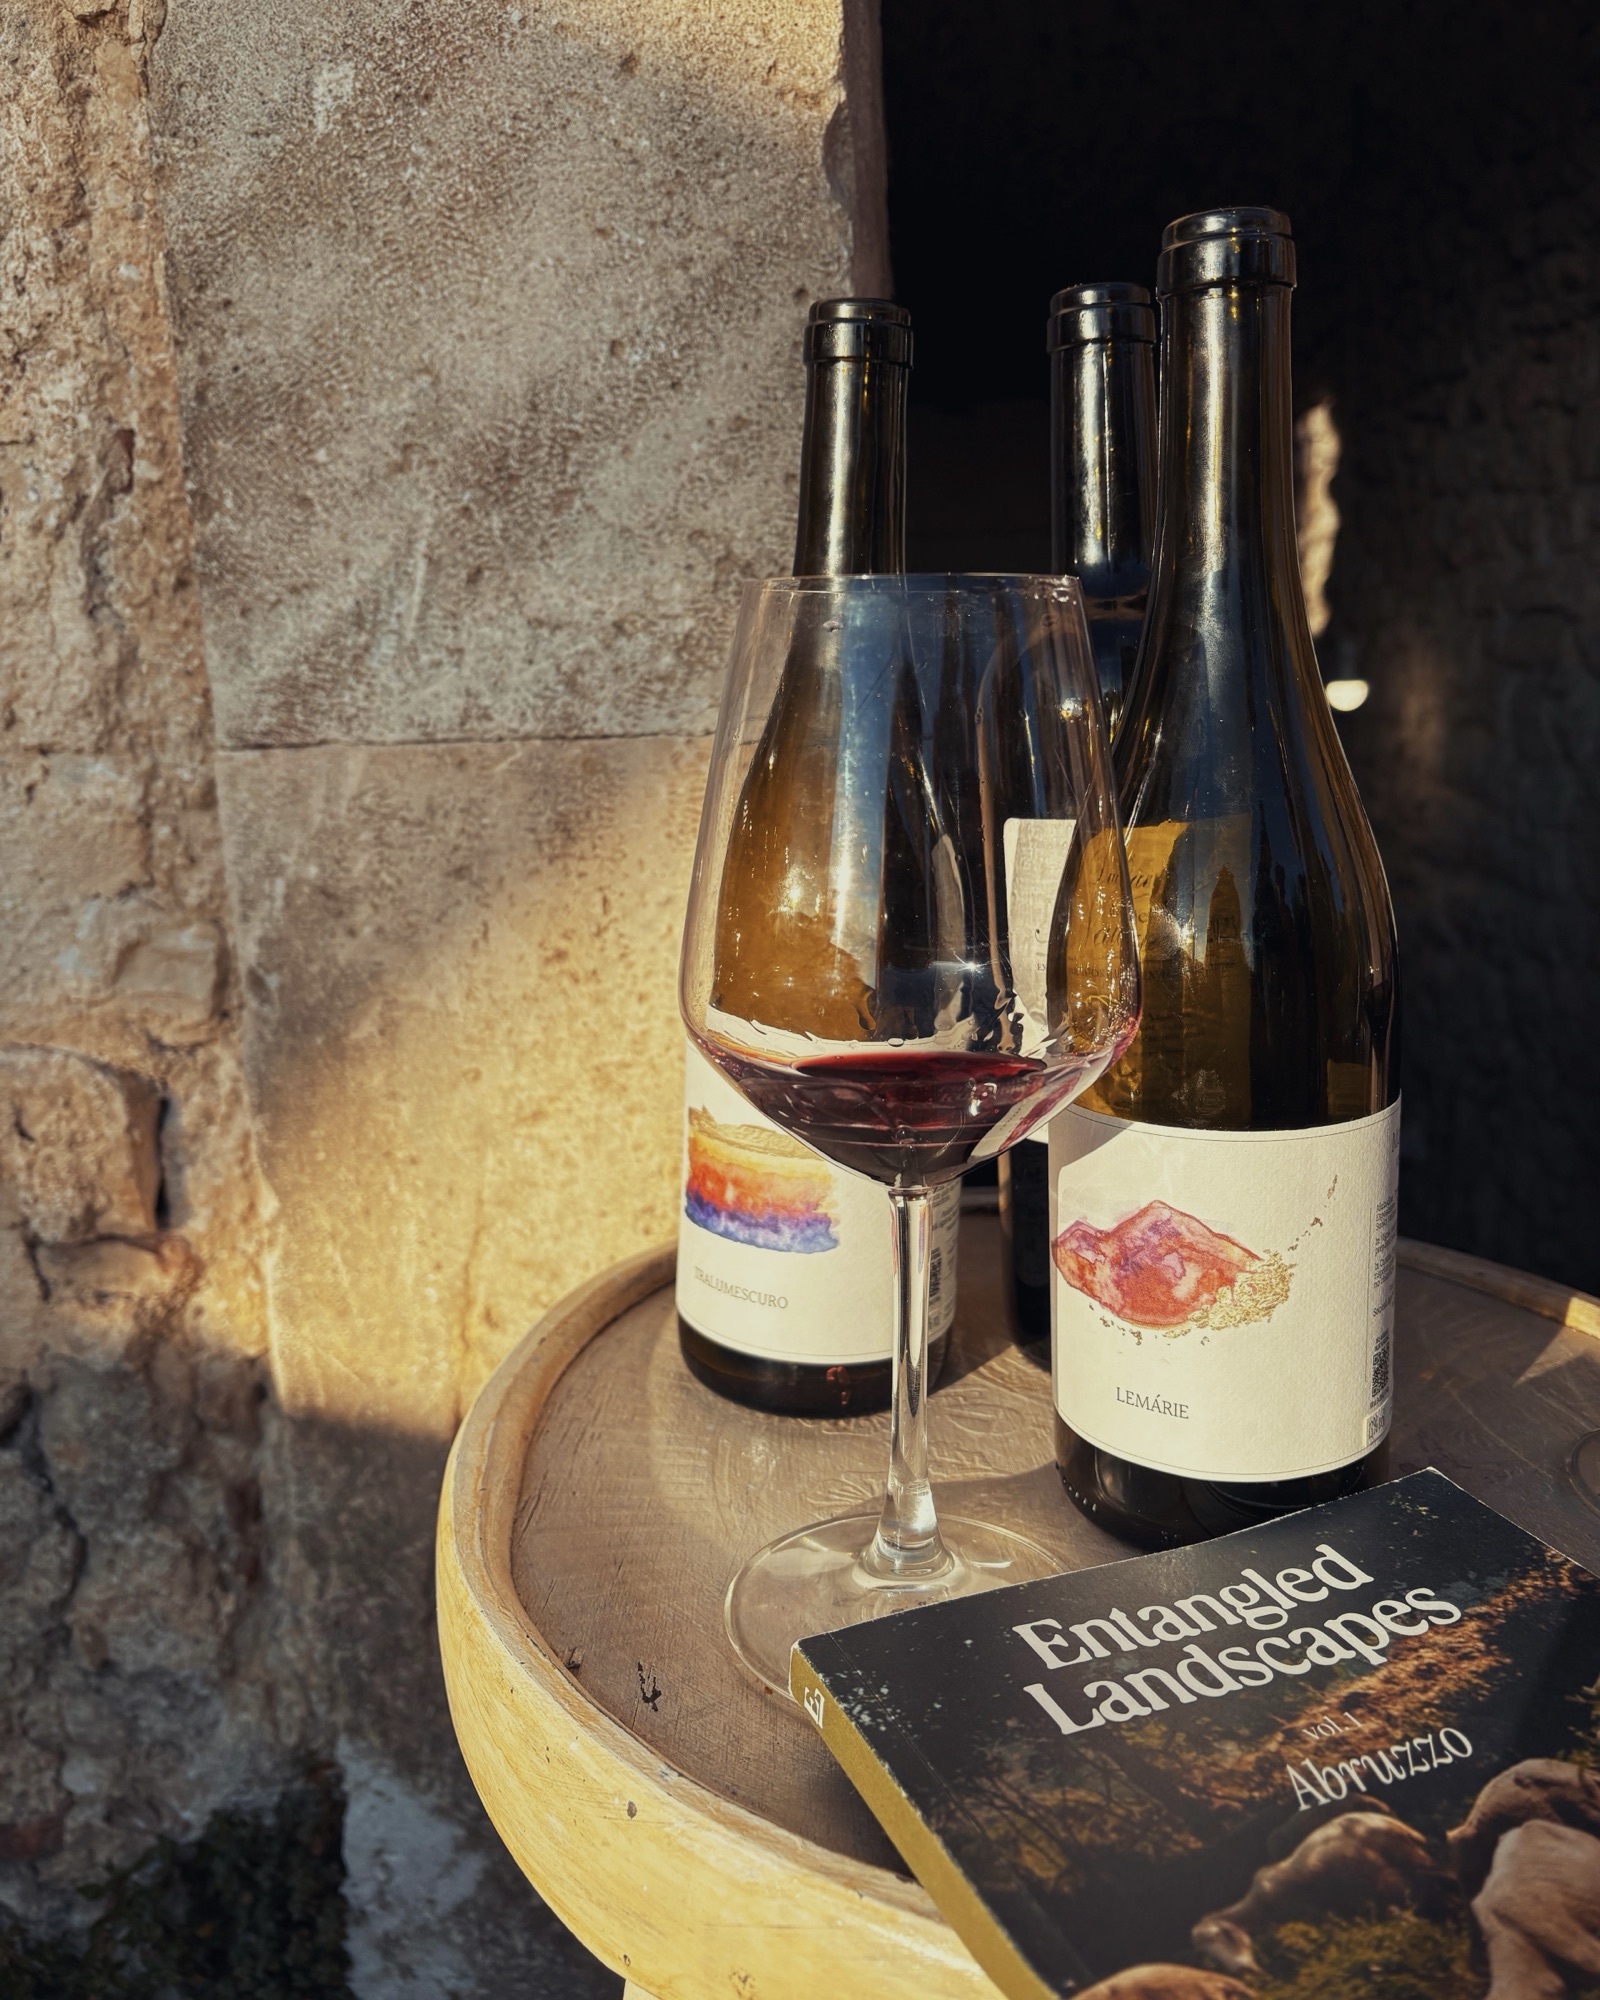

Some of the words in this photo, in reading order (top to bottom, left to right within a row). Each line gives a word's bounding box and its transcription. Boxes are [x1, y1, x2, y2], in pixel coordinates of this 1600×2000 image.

[694, 1266, 789, 1309] TRALUMESCURO
[1116, 1386, 1189, 1419] LEMÁRIE
[1012, 1544, 1374, 1669] Entangled
[1023, 1587, 1462, 1735] Landscapes
[1286, 1727, 1473, 1812] Abruzzo
